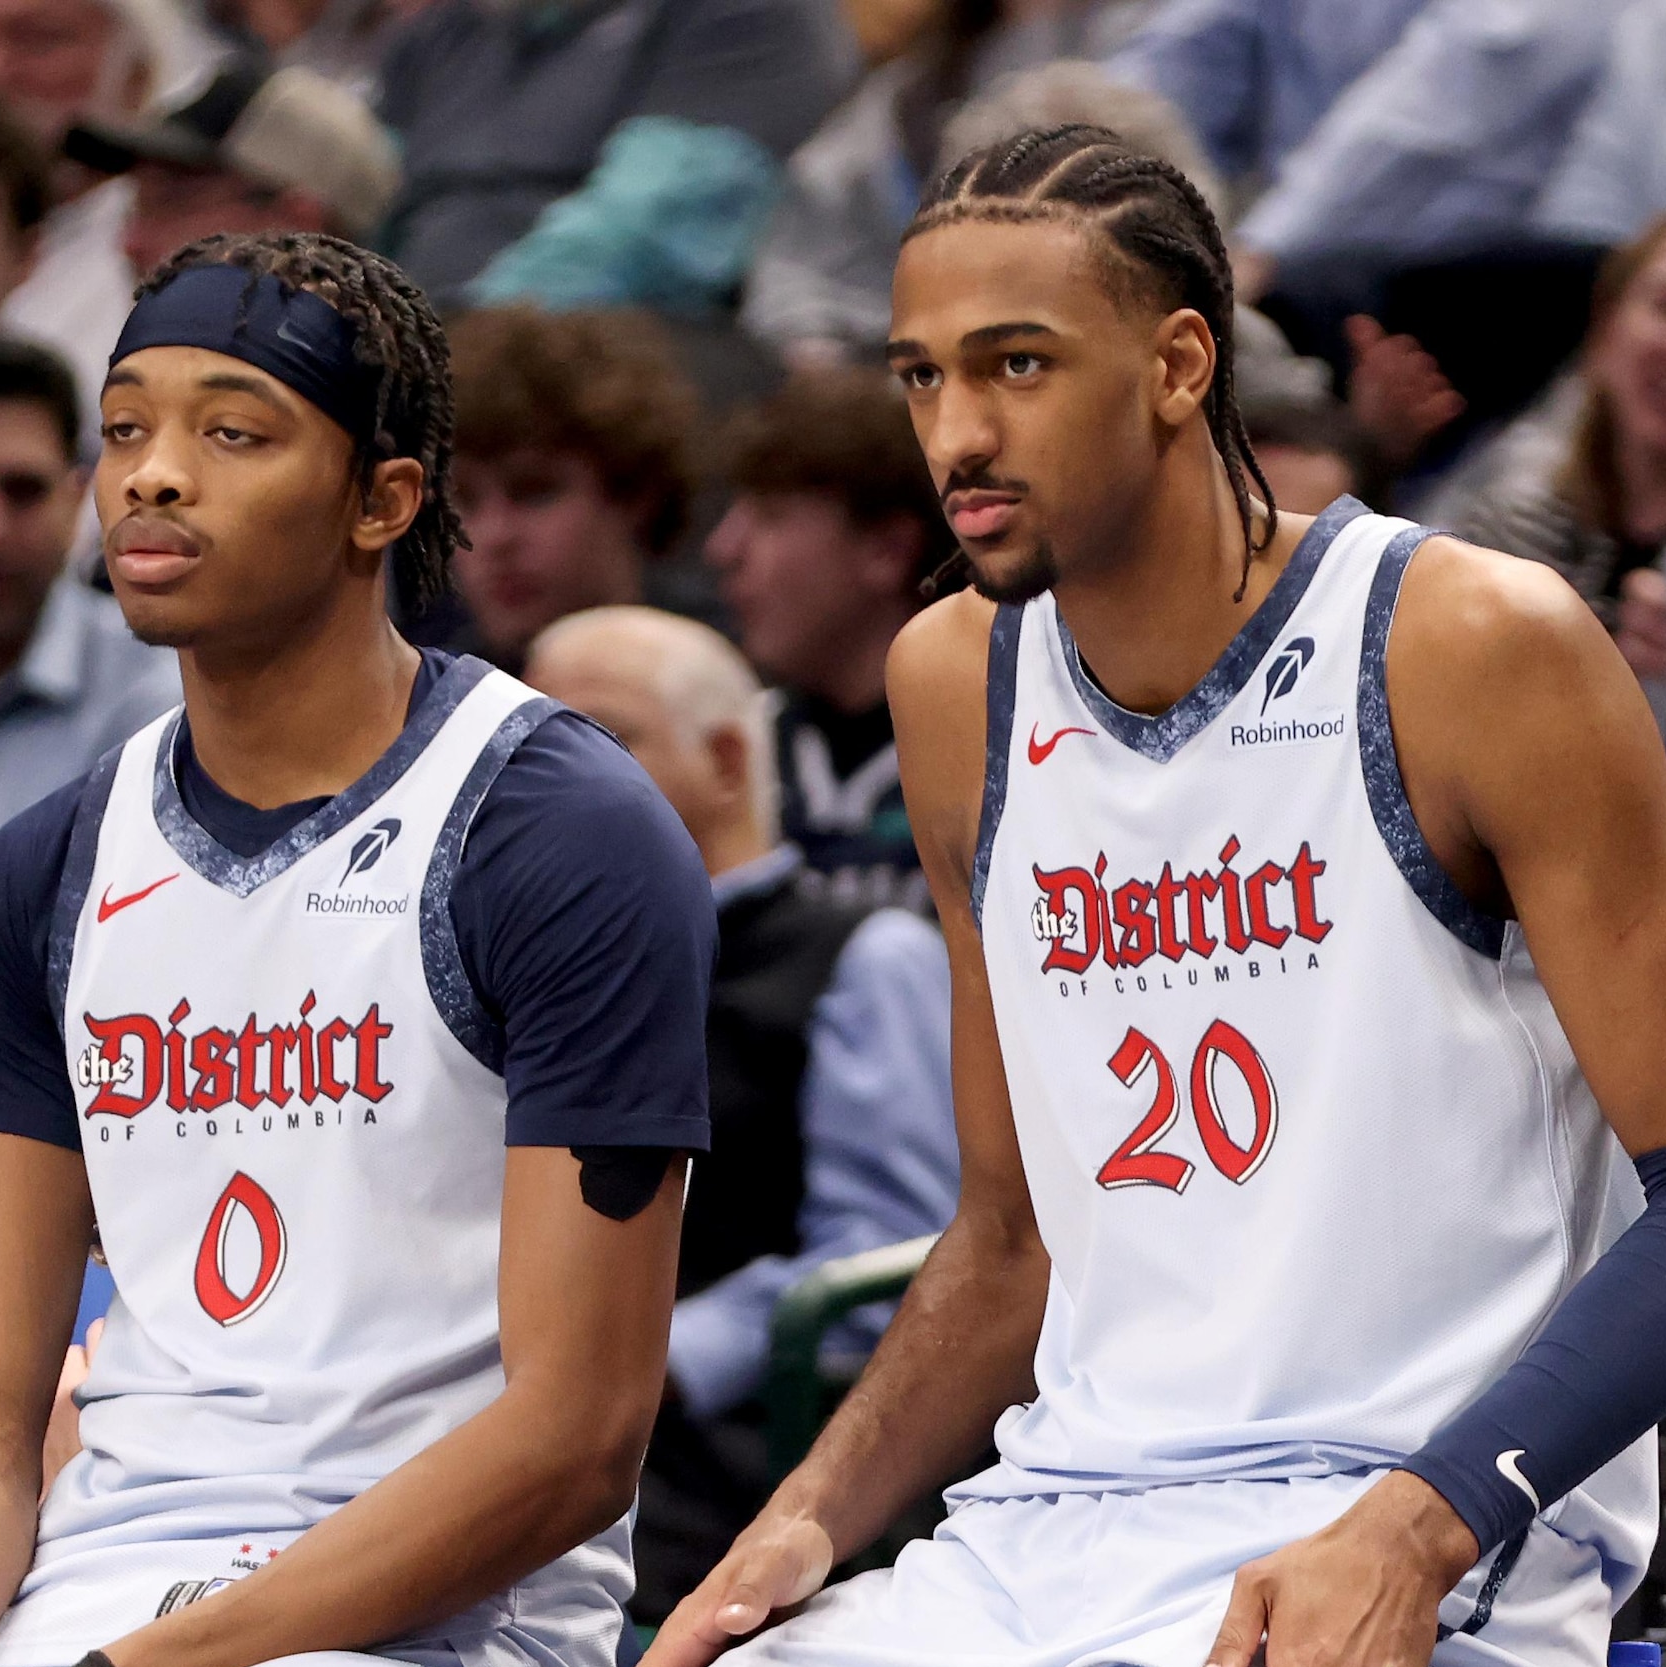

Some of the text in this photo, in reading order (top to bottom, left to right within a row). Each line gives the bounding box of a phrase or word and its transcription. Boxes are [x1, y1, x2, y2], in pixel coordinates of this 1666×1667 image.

[1231, 714, 1344, 745] Robinhood
[306, 892, 408, 915] Robinhood
[1030, 899, 1077, 941] the
[1031, 833, 1334, 976] District
[1059, 953, 1320, 997] OF COLUMBIA
[77, 990, 394, 1120] the District
[100, 1108, 378, 1143] OF COLUMBIA
[1095, 1018, 1279, 1195] 20
[194, 1169, 287, 1328] 0
